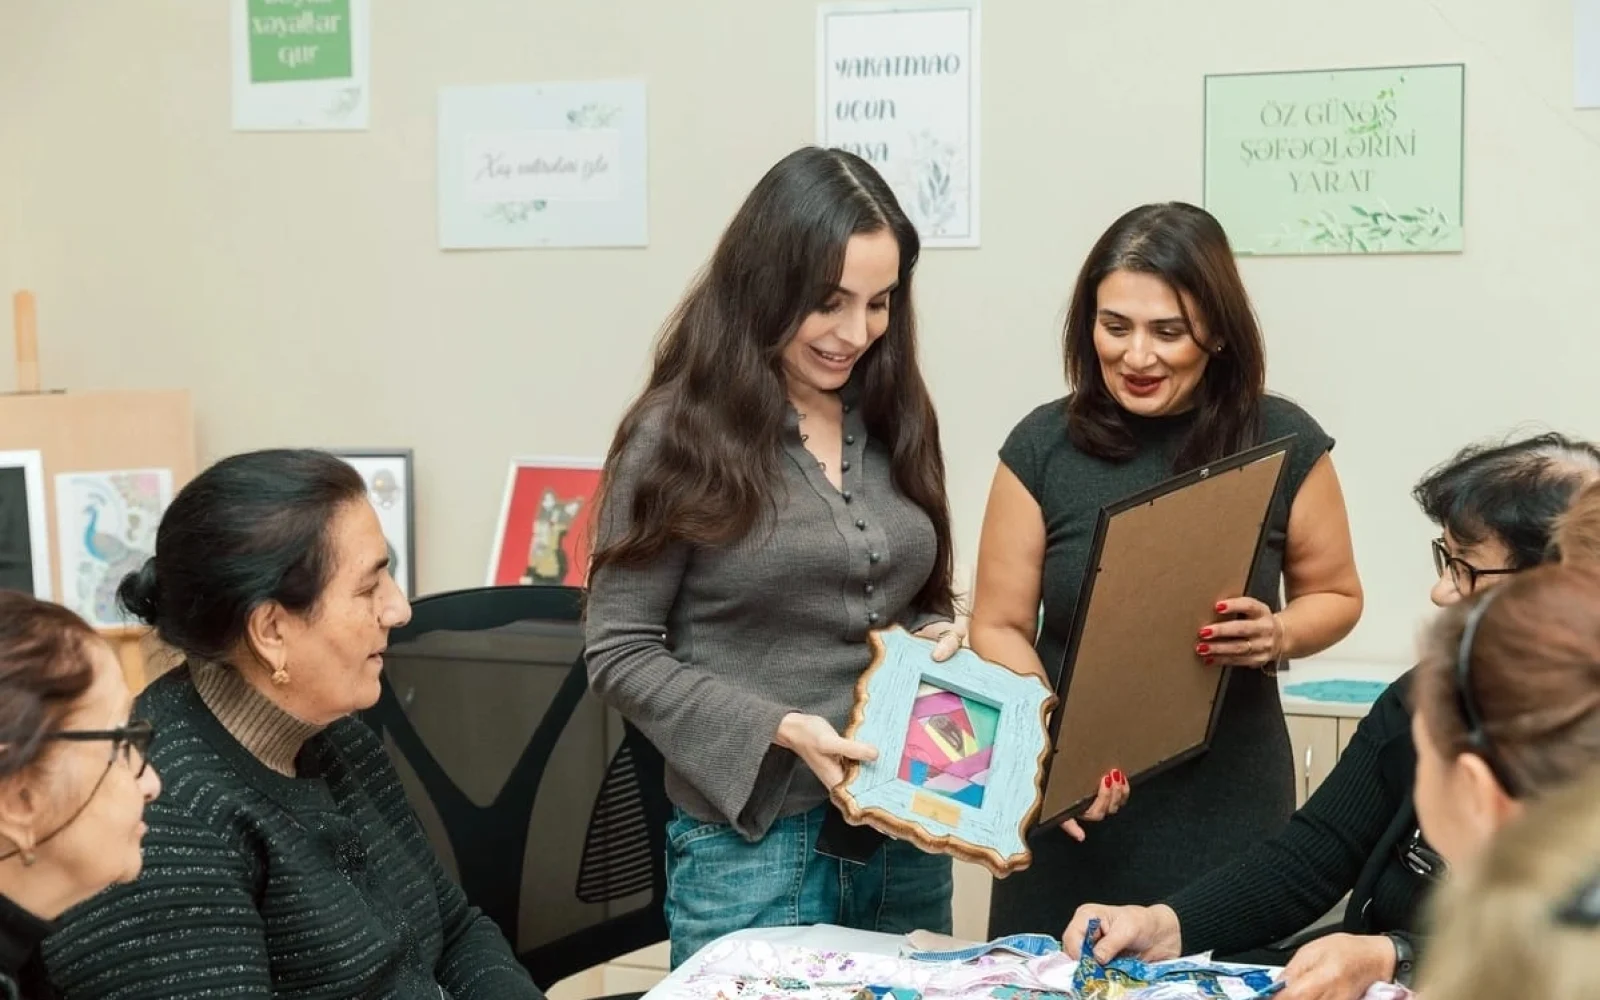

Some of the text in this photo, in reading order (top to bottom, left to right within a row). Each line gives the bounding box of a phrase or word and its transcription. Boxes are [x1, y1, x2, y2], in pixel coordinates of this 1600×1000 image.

[278, 45, 319, 68] qur
[1260, 99, 1297, 127] ÖZ
[1240, 129, 1416, 167] ŞƏFƏQLƏRİNİ
[1289, 168, 1376, 194] YARAT
